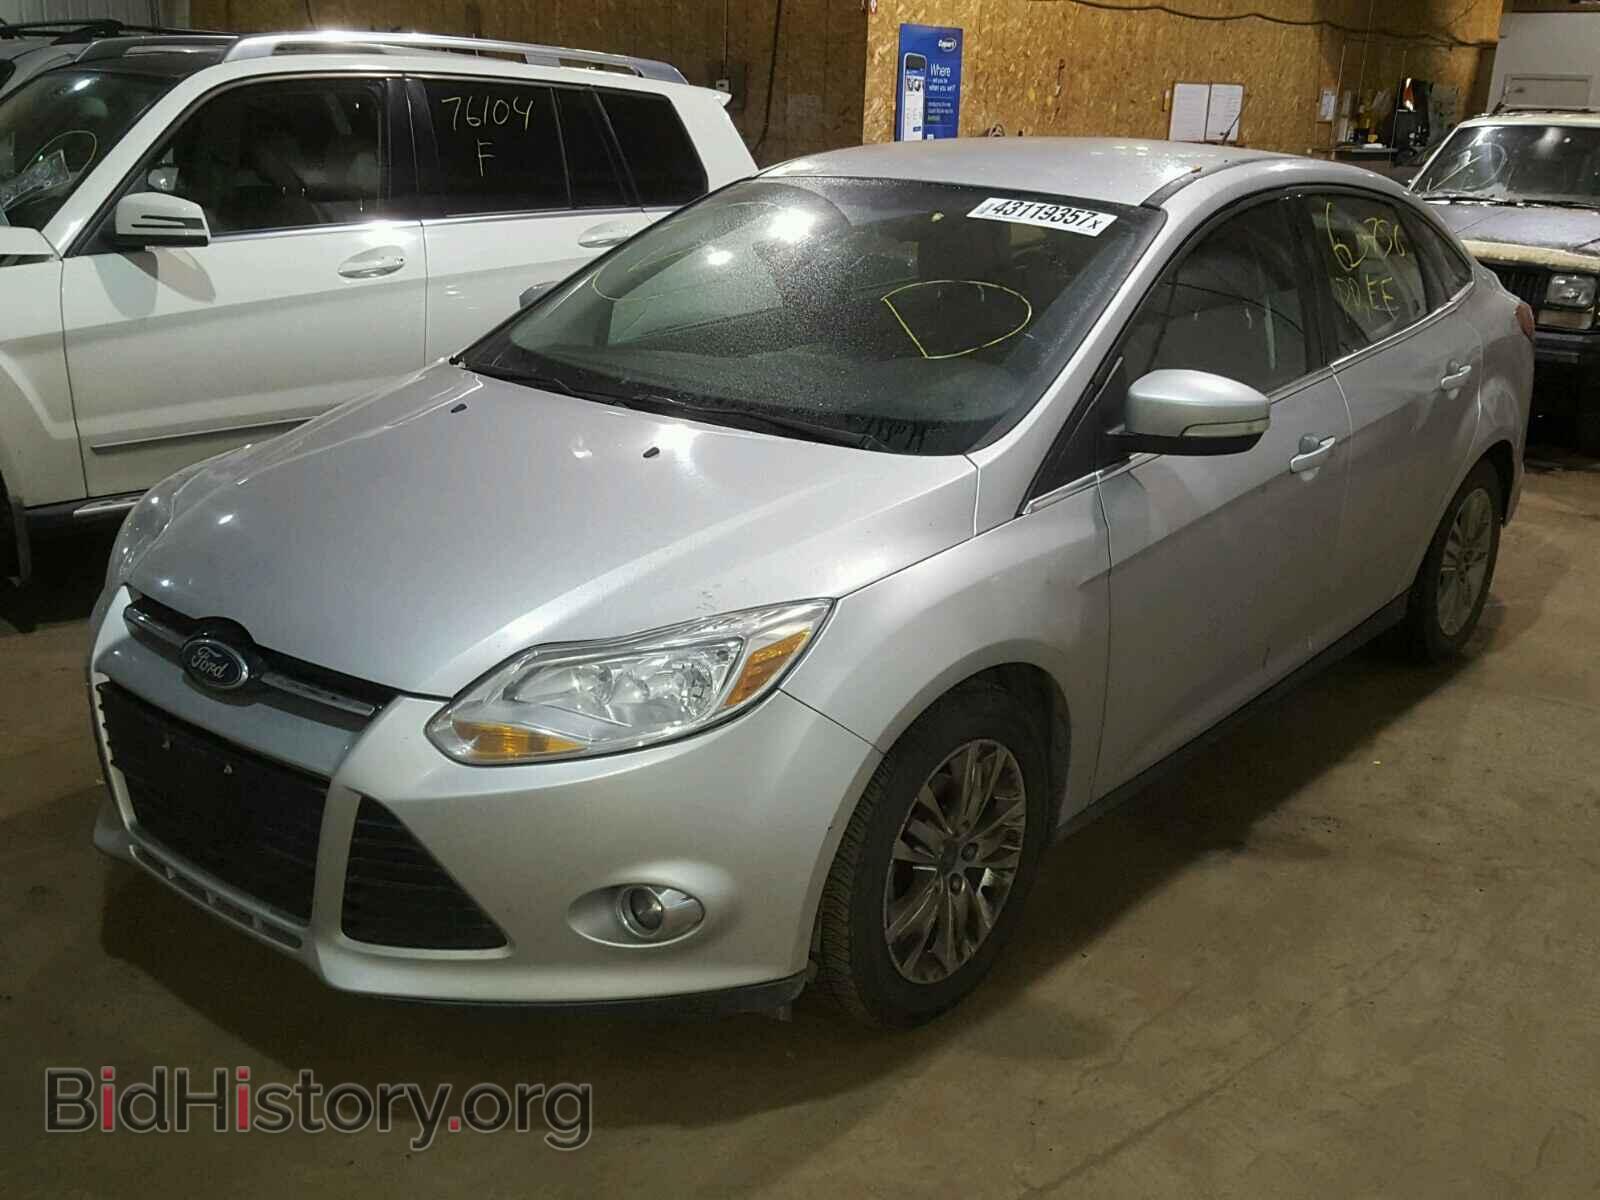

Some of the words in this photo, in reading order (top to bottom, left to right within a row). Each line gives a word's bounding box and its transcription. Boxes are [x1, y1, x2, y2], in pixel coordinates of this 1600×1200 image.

[930, 63, 951, 77] Where
[441, 96, 534, 131] 76104
[476, 138, 496, 177] F
[191, 646, 230, 679] Ford
